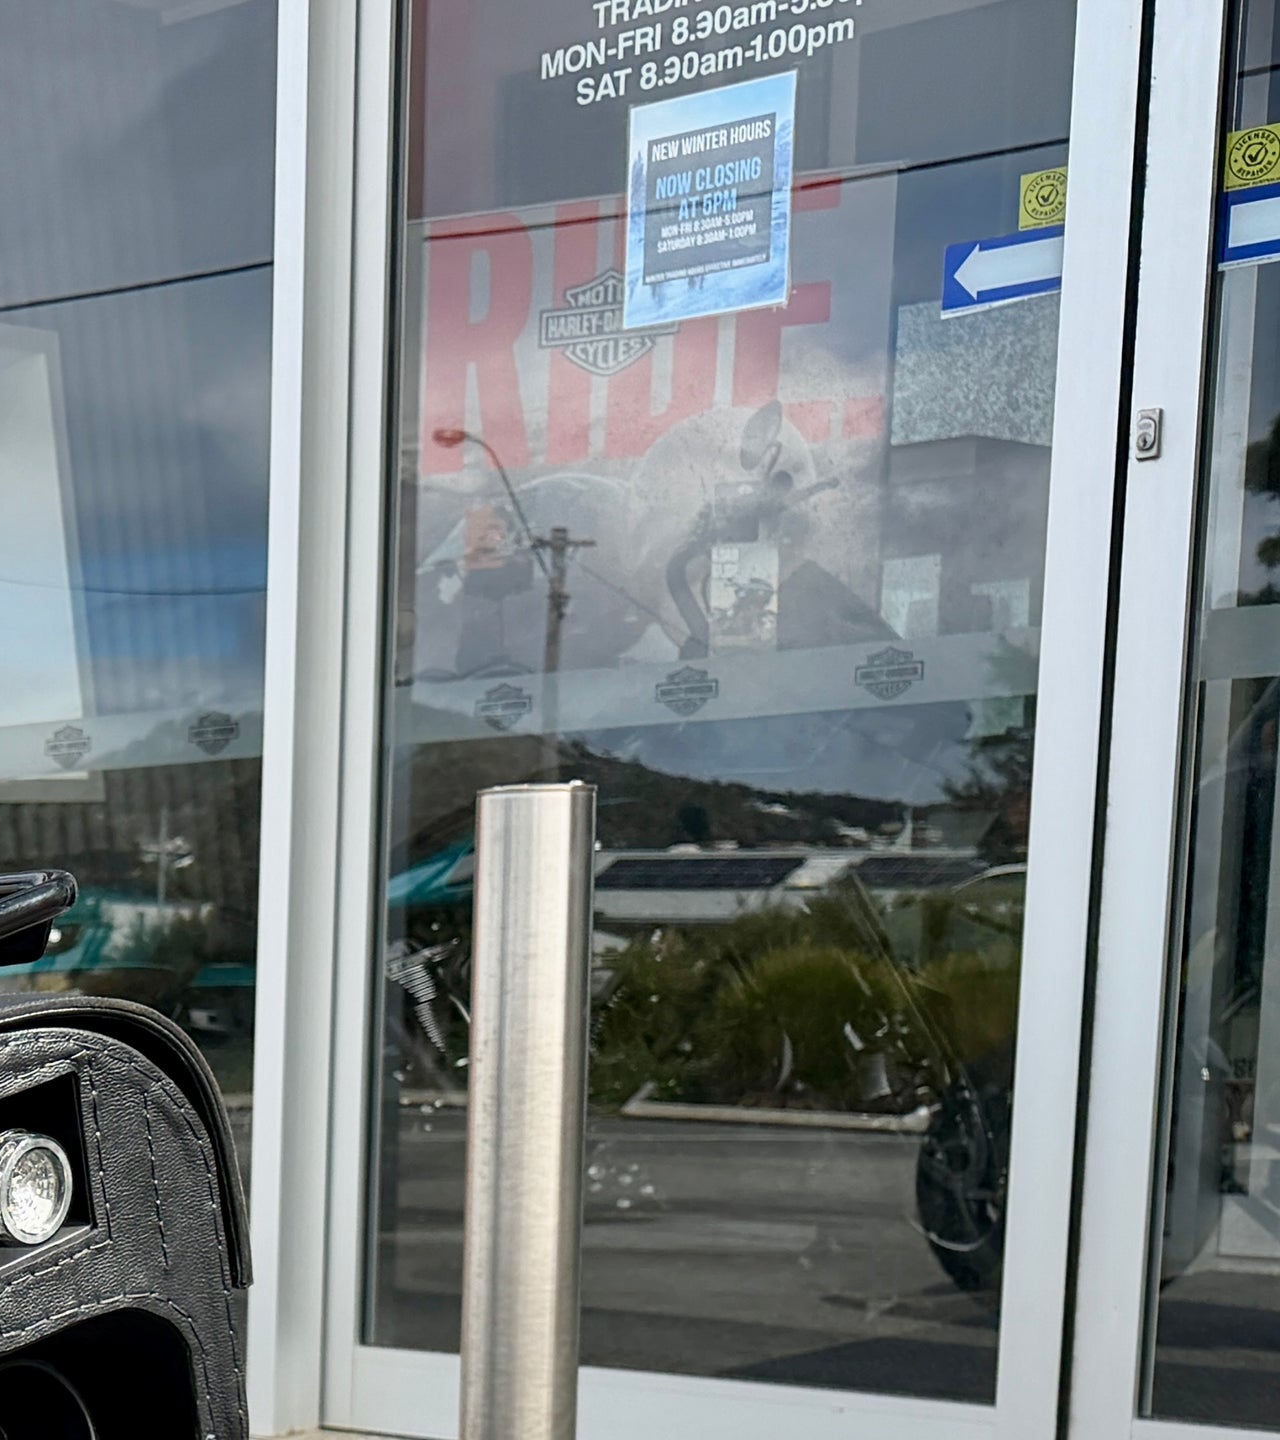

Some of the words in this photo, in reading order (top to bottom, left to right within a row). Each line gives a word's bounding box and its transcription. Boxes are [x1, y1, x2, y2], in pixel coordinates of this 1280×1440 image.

[541, 23, 662, 80] MON-FRI
[576, 68, 632, 106] SAT
[651, 140, 680, 162] NEW
[682, 129, 728, 155] WINTER
[730, 119, 772, 145] HOURS
[655, 171, 692, 199] NOW
[695, 156, 762, 192] CLOSING
[678, 196, 700, 221] AT
[702, 188, 738, 216] 5PM
[657, 235, 696, 254] SATURDAY
[547, 309, 626, 339] HARLEY-DA
[573, 336, 641, 370] CYCLES
